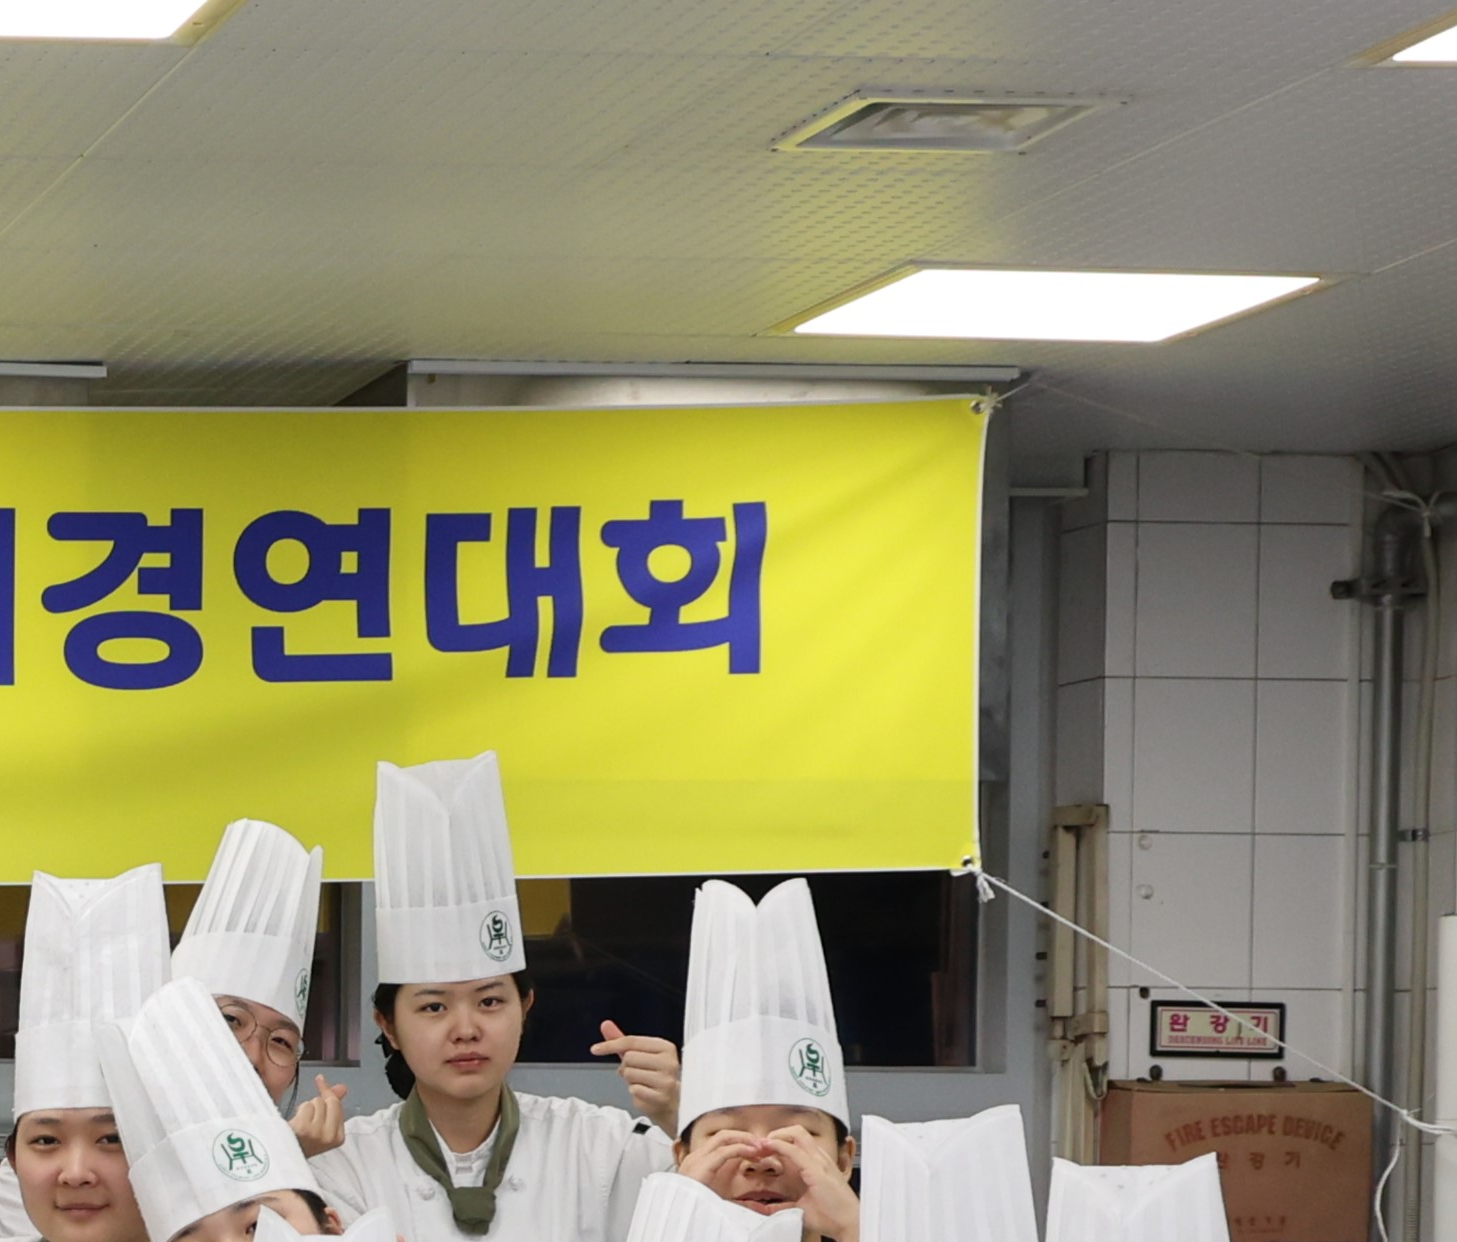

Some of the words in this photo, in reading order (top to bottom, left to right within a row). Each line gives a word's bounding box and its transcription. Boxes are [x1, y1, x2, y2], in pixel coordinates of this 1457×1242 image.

[1168, 1034, 1224, 1045] DESCENDING
[1247, 1037, 1268, 1047] LINE
[1164, 1120, 1206, 1153] FIRE
[1210, 1113, 1277, 1138] ESCAPE
[1281, 1115, 1346, 1150] DEVICE
